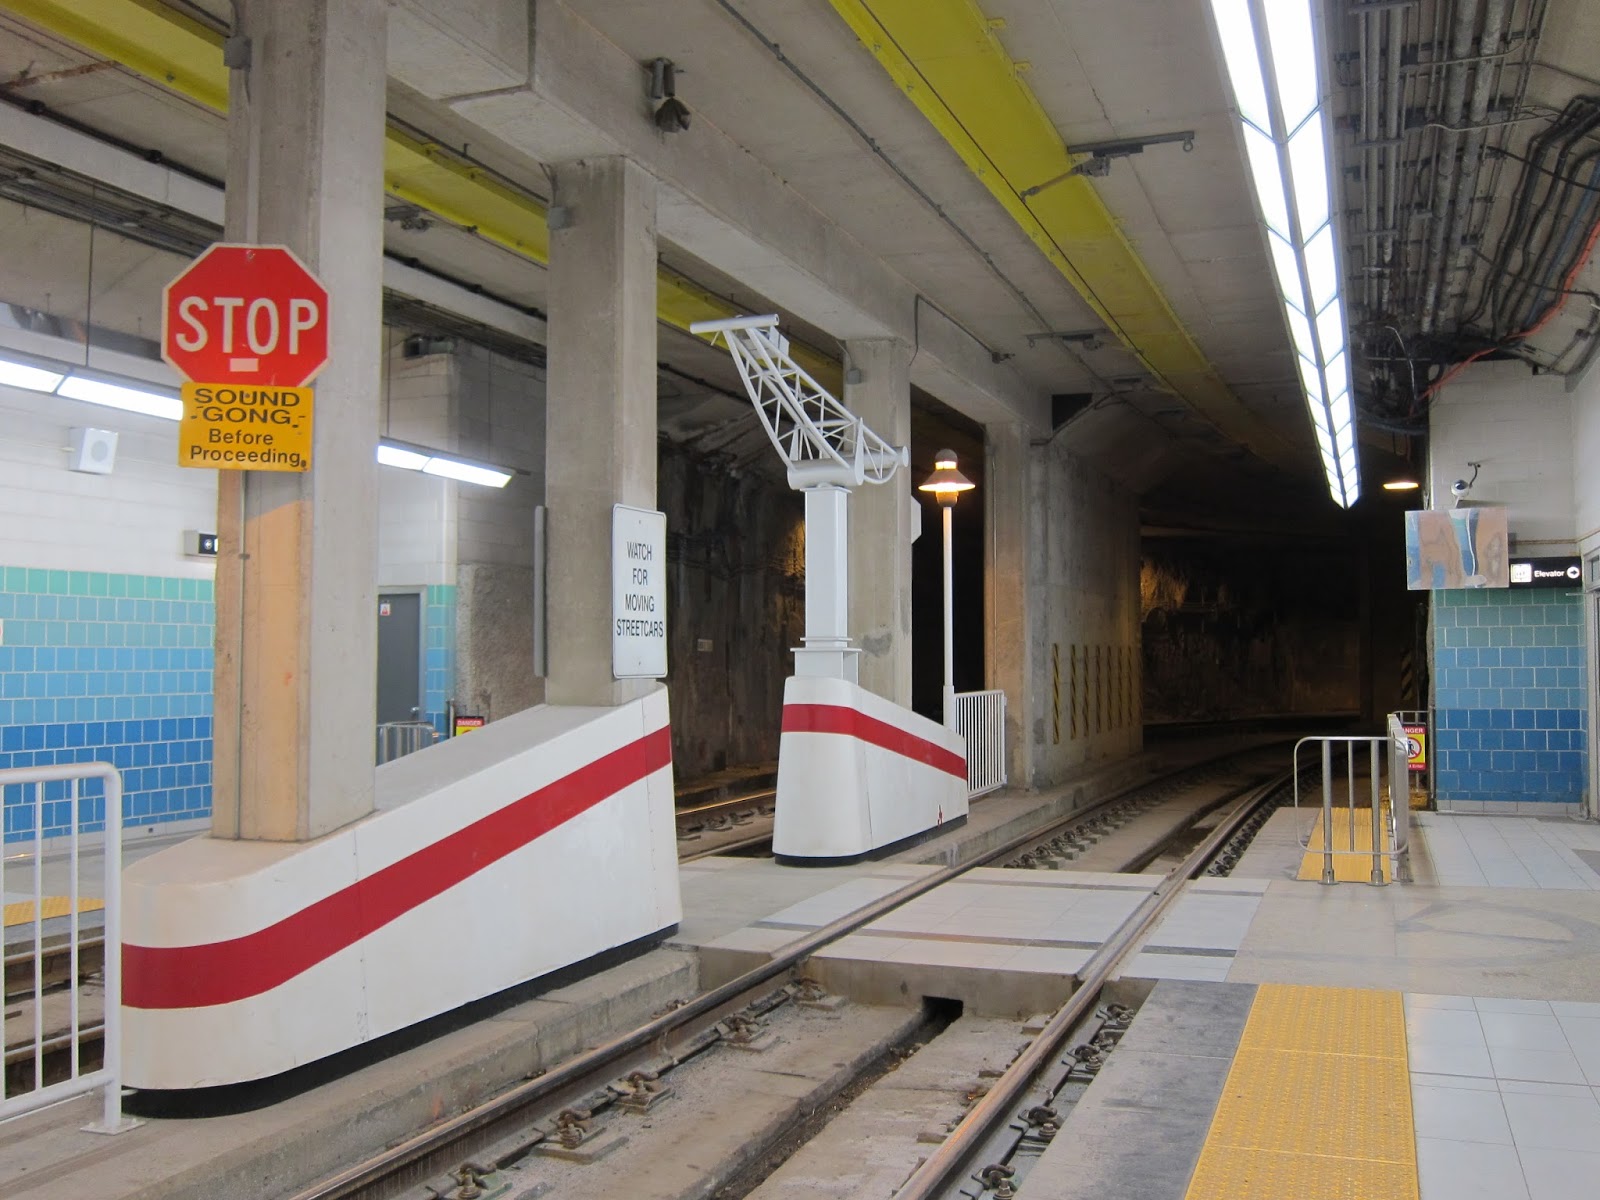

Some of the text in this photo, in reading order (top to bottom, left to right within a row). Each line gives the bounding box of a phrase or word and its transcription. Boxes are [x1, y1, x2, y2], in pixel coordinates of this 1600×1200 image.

[175, 296, 319, 355] STOP
[194, 388, 300, 407] SOUND
[203, 406, 290, 425] GONG
[209, 428, 273, 445] Before
[190, 445, 301, 468] Proceeding
[626, 541, 652, 561] WATCH
[632, 567, 648, 586] FOR
[1534, 570, 1565, 578] Elevator
[625, 593, 655, 612] MOVING
[616, 618, 664, 638] STREETCARS
